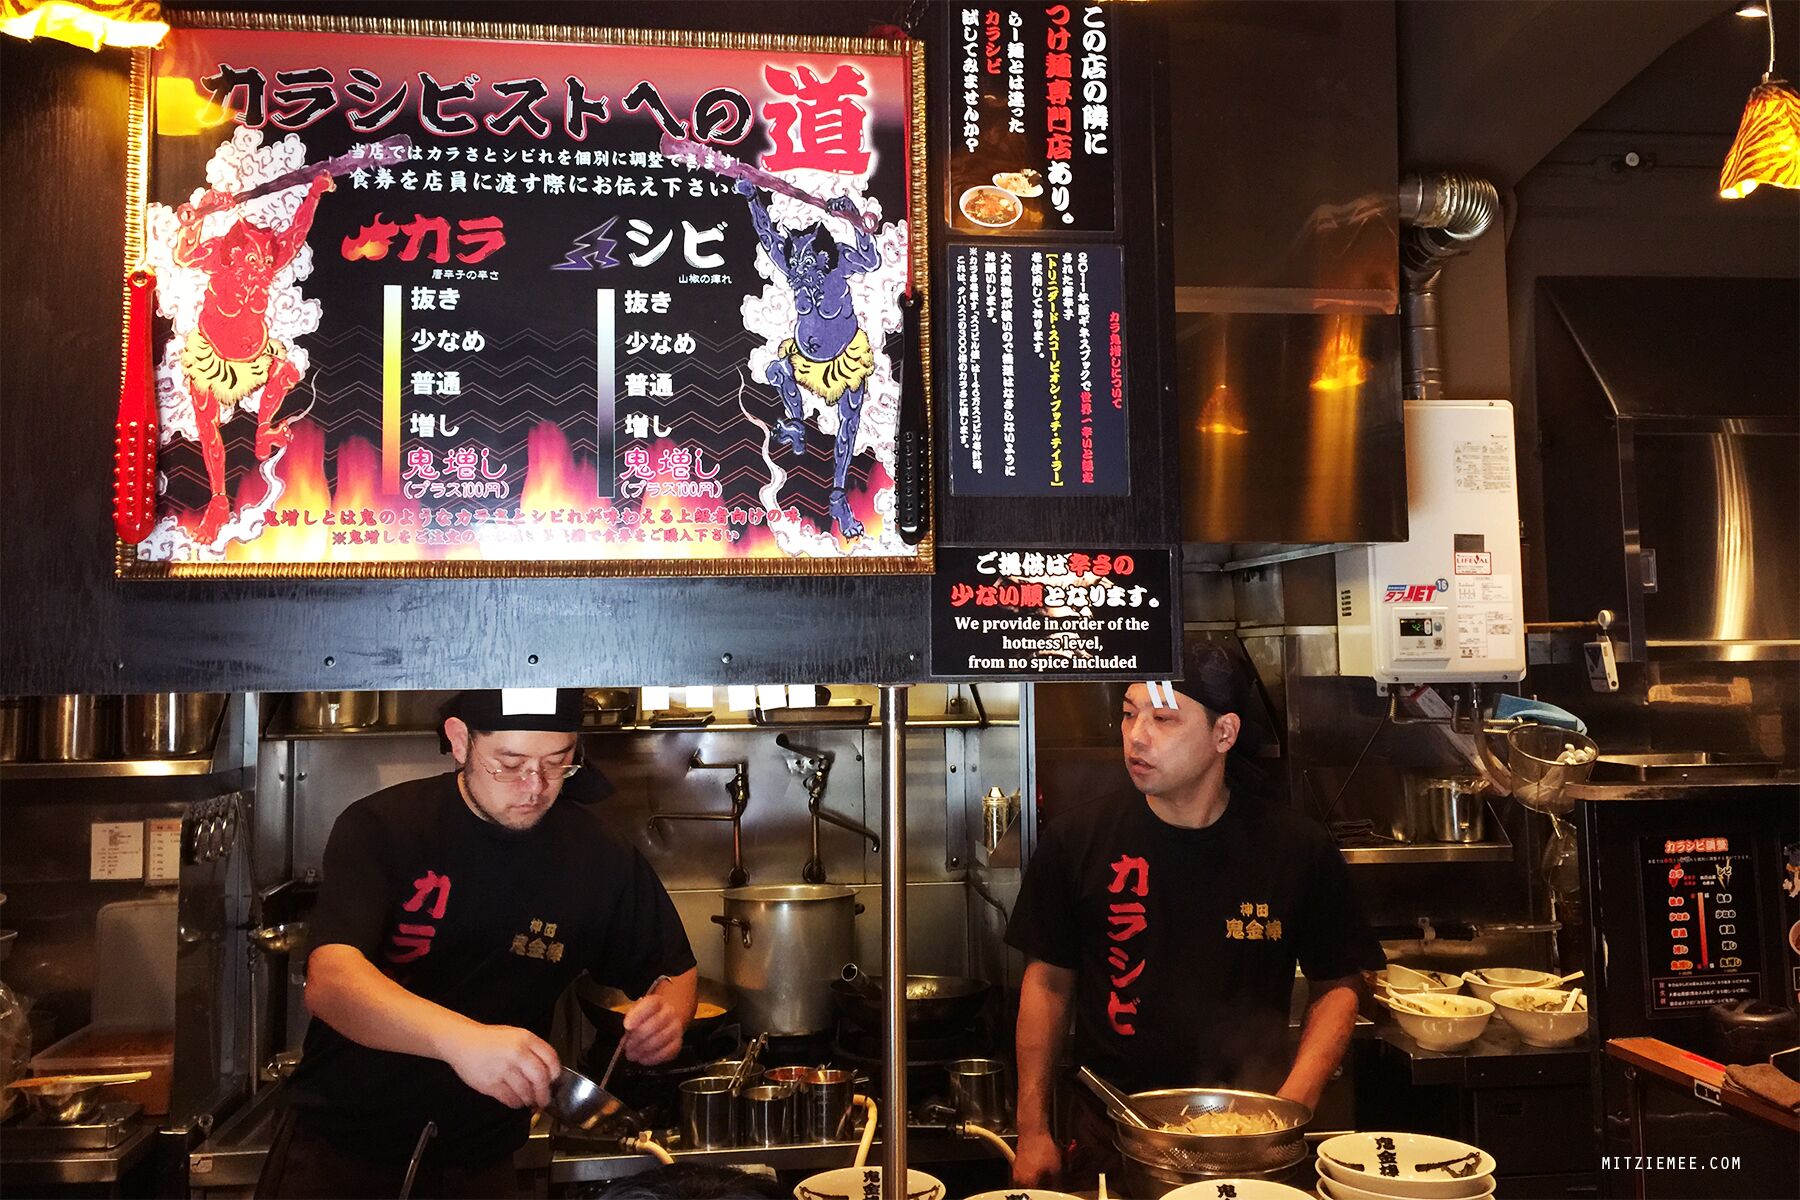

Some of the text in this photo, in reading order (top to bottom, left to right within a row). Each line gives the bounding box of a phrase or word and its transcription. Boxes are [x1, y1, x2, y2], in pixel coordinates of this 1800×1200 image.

[985, 10, 1002, 75] カラシビ
[1007, 11, 1025, 133] らー麺とは違った
[1081, 6, 1108, 155] この店の隣に
[200, 63, 874, 177] カラシビストへの道
[1046, 4, 1075, 224] つけ麺専門店あり。
[397, 213, 506, 264] カラ
[626, 218, 730, 270] シビ
[411, 286, 461, 311] 抜き
[624, 289, 672, 315] 抜き
[411, 328, 486, 353] 少なめ
[625, 331, 697, 355] 少なめ
[410, 371, 462, 396] 普通
[624, 372, 674, 398] 普通
[410, 412, 460, 438] 増し
[624, 414, 673, 439] 増し
[402, 446, 508, 480] 鬼増し
[619, 446, 721, 480] 鬼増し
[403, 480, 510, 500] (プラス100円)
[620, 480, 723, 499] (プラス100円)
[976, 550, 1135, 577] ご提供は辛さの
[951, 583, 1160, 608] 少ない順となります。
[954, 616, 1150, 633] We provide in order of the
[1002, 635, 1104, 651] hotness level,
[968, 655, 1138, 672] from no spice included
[1240, 901, 1270, 918] 神田
[1107, 854, 1151, 1036] カラシビ
